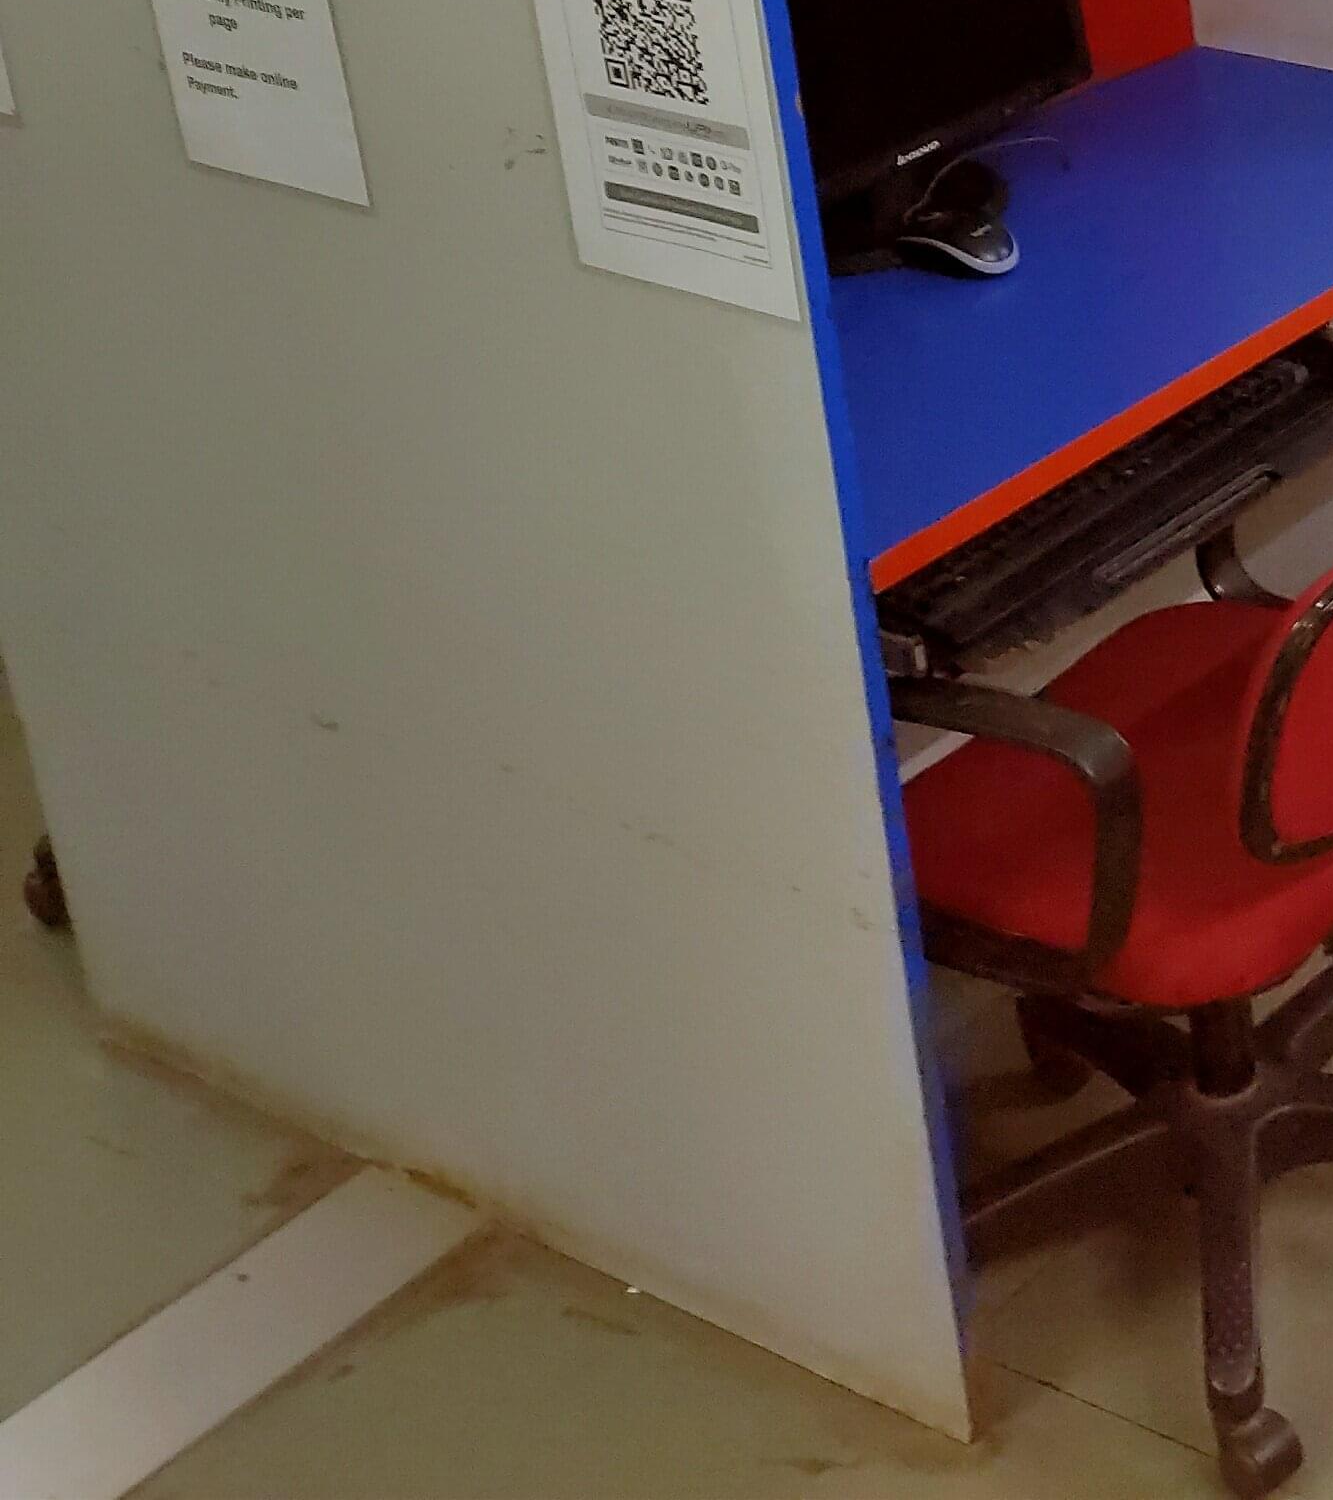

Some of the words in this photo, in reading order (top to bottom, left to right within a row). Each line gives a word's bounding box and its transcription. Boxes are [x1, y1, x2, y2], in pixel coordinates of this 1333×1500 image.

[285, 6, 305, 20] per
[208, 14, 238, 31] page
[182, 51, 222, 73] Please
[225, 62, 257, 81] make
[260, 71, 298, 90] online
